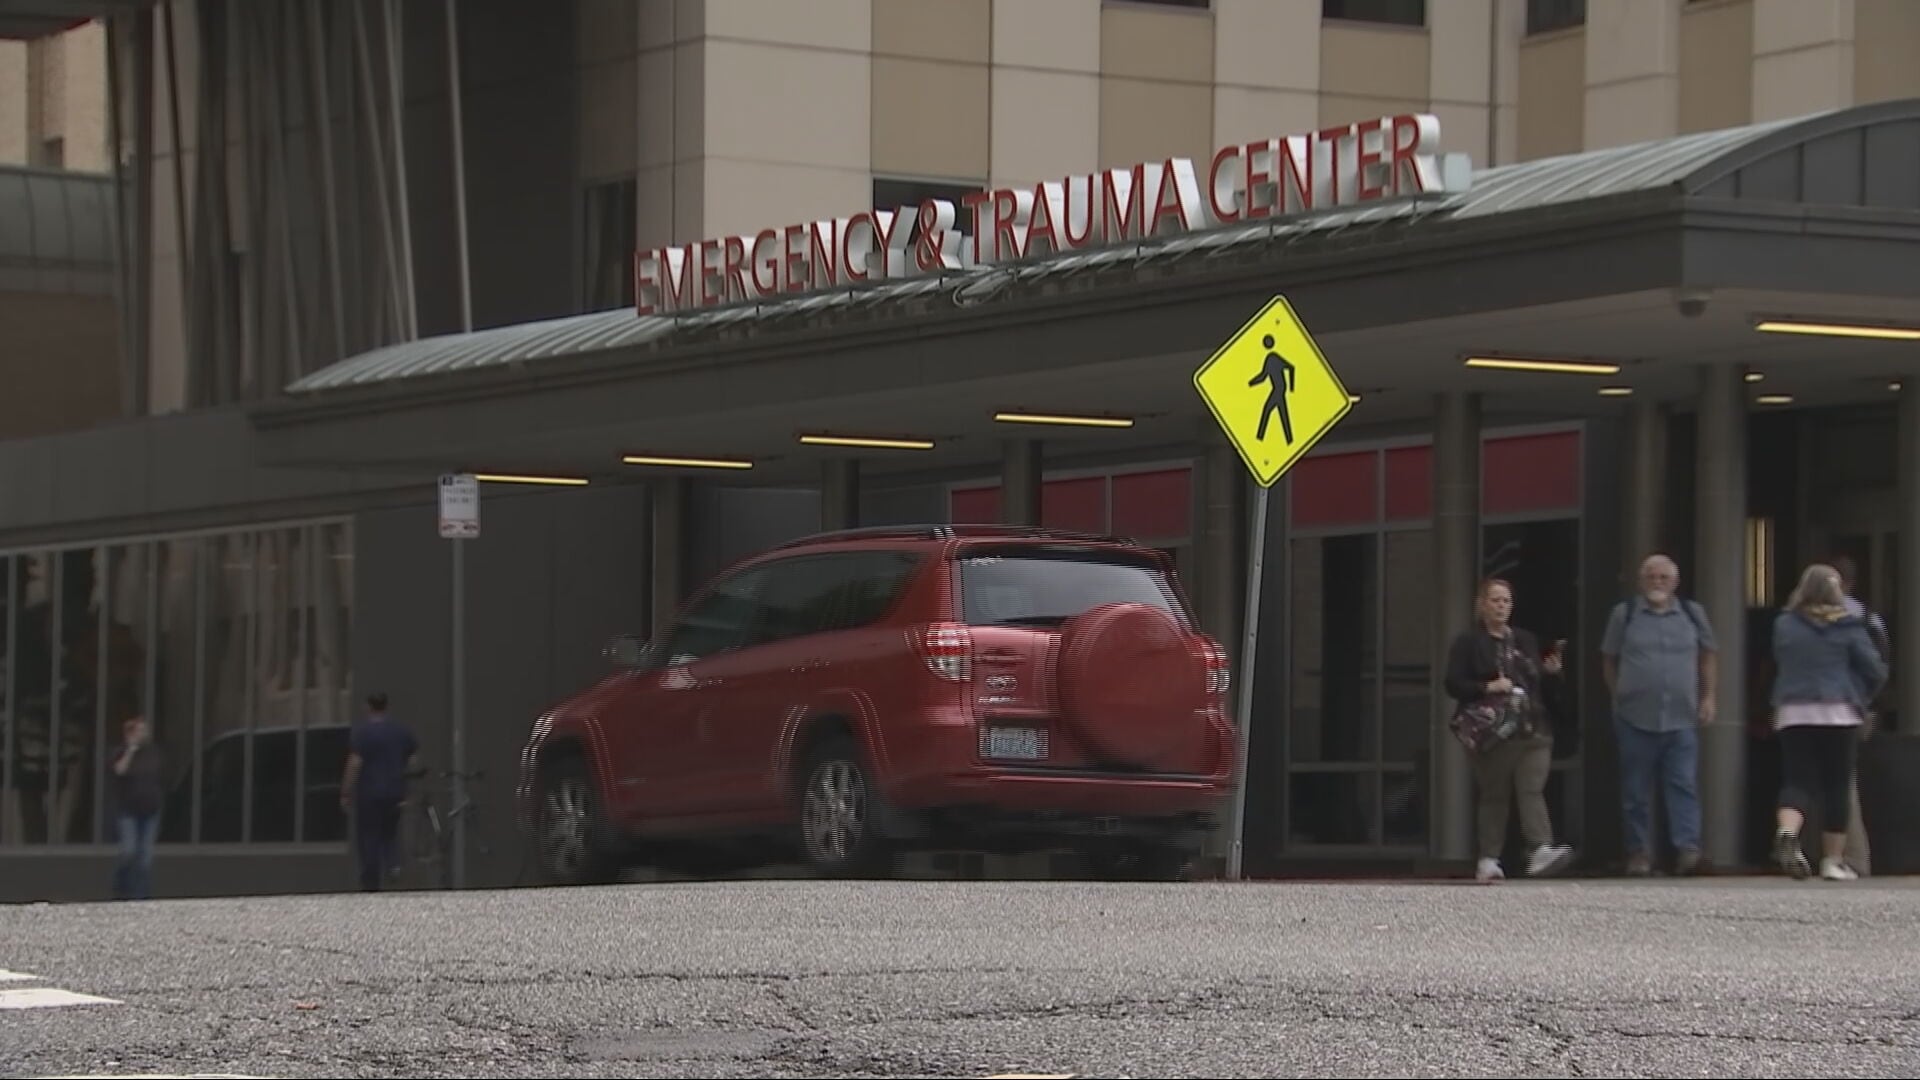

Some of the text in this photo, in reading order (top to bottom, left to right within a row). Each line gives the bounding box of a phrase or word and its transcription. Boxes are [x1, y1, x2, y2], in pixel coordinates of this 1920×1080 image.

[635, 114, 1425, 317] EMERGENCY & TRAUMA CENTER
